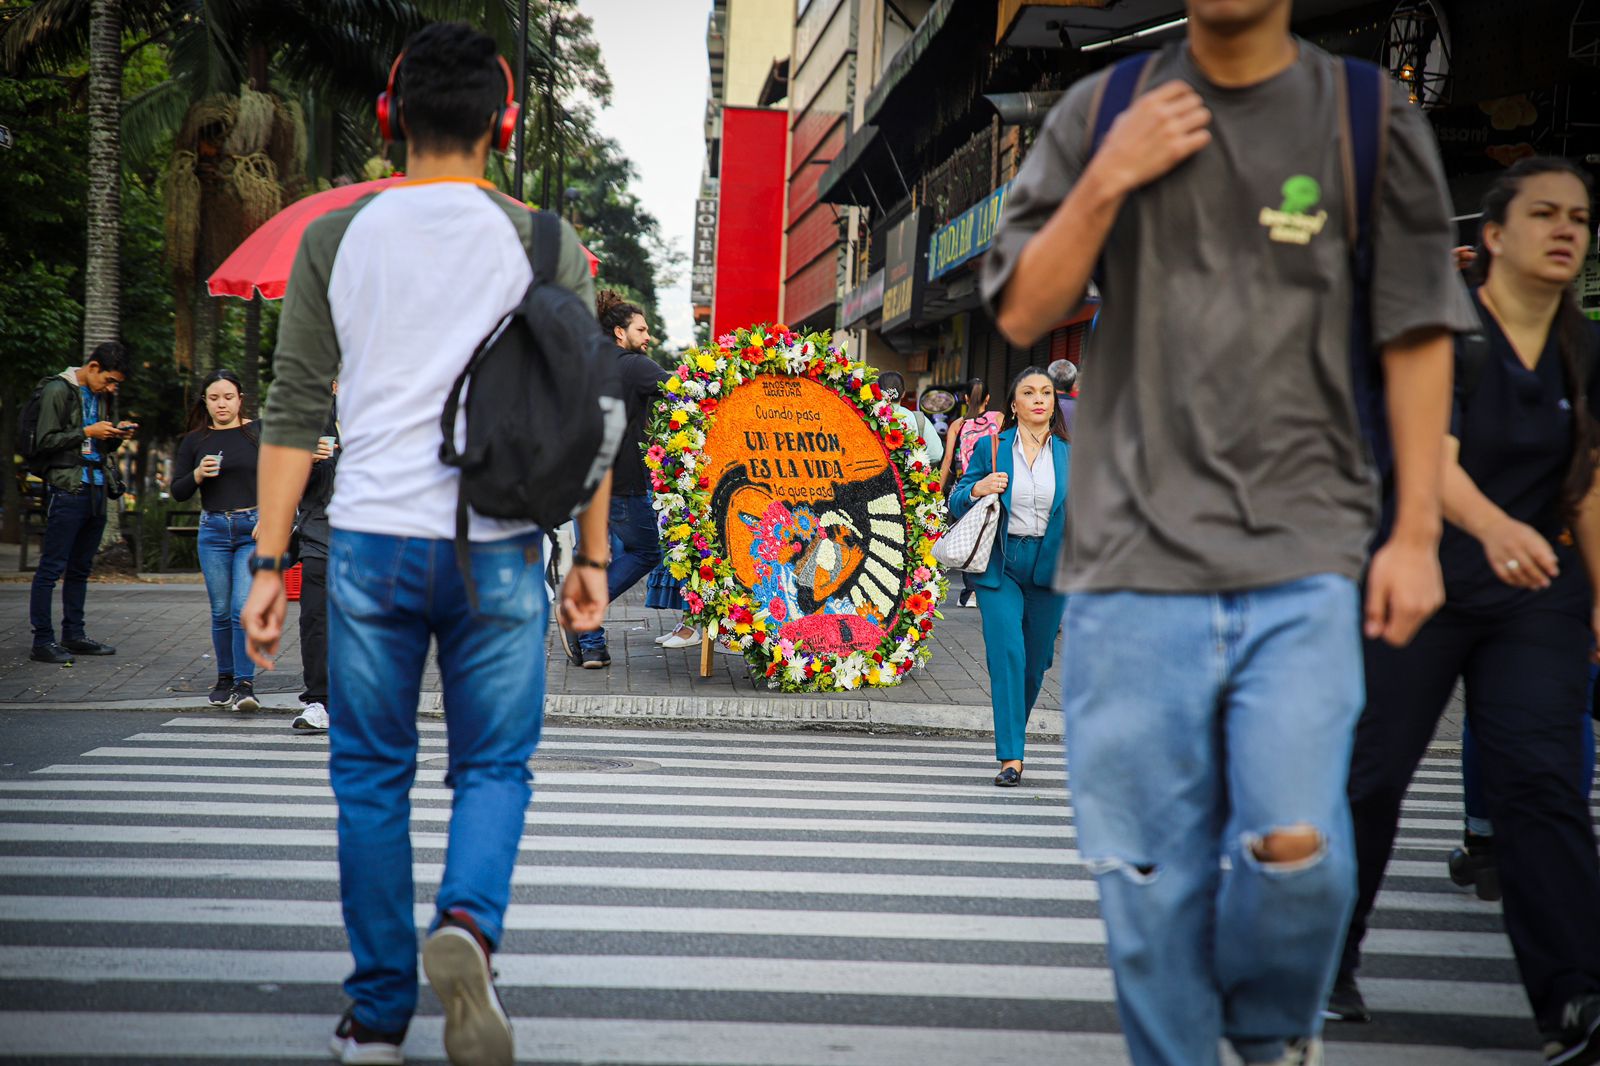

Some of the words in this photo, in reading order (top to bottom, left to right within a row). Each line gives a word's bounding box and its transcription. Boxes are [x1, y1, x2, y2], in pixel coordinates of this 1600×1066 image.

[697, 201, 715, 264] HOTEL
[755, 405, 793, 420] Cuando
[796, 410, 821, 424] pasa
[743, 431, 769, 451] UN
[773, 426, 846, 455] PEATÓN,
[749, 459, 771, 478] ES
[775, 459, 799, 478] LA
[803, 459, 844, 478] VIDA
[774, 483, 785, 497] la
[788, 485, 807, 501] que
[809, 486, 833, 500] pasa
